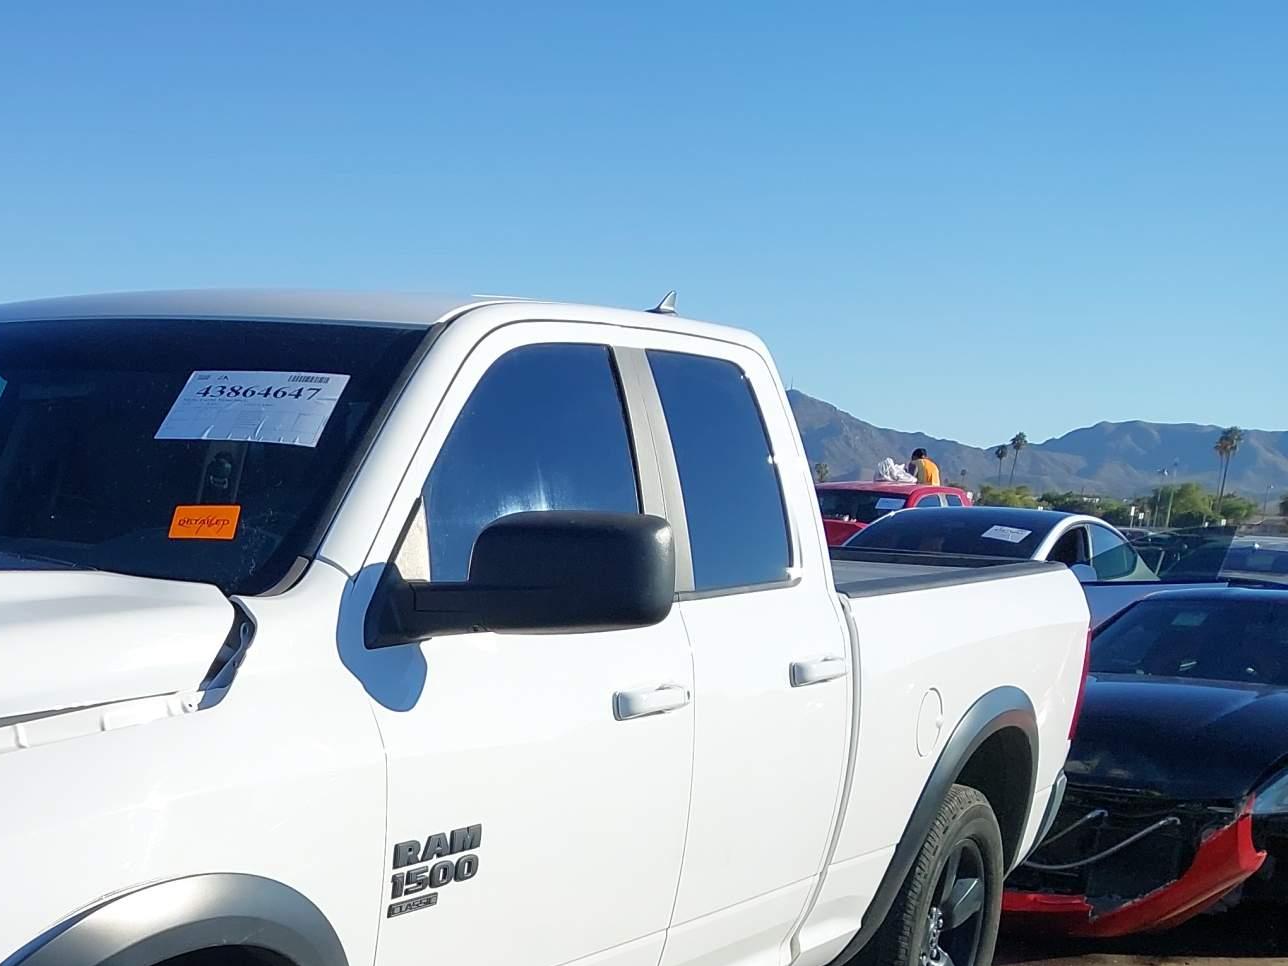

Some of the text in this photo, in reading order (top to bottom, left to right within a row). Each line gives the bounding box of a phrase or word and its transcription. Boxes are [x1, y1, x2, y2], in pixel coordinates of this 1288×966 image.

[196, 384, 322, 400] 43864647
[392, 823, 482, 869] RAM
[391, 853, 479, 900] 1500
